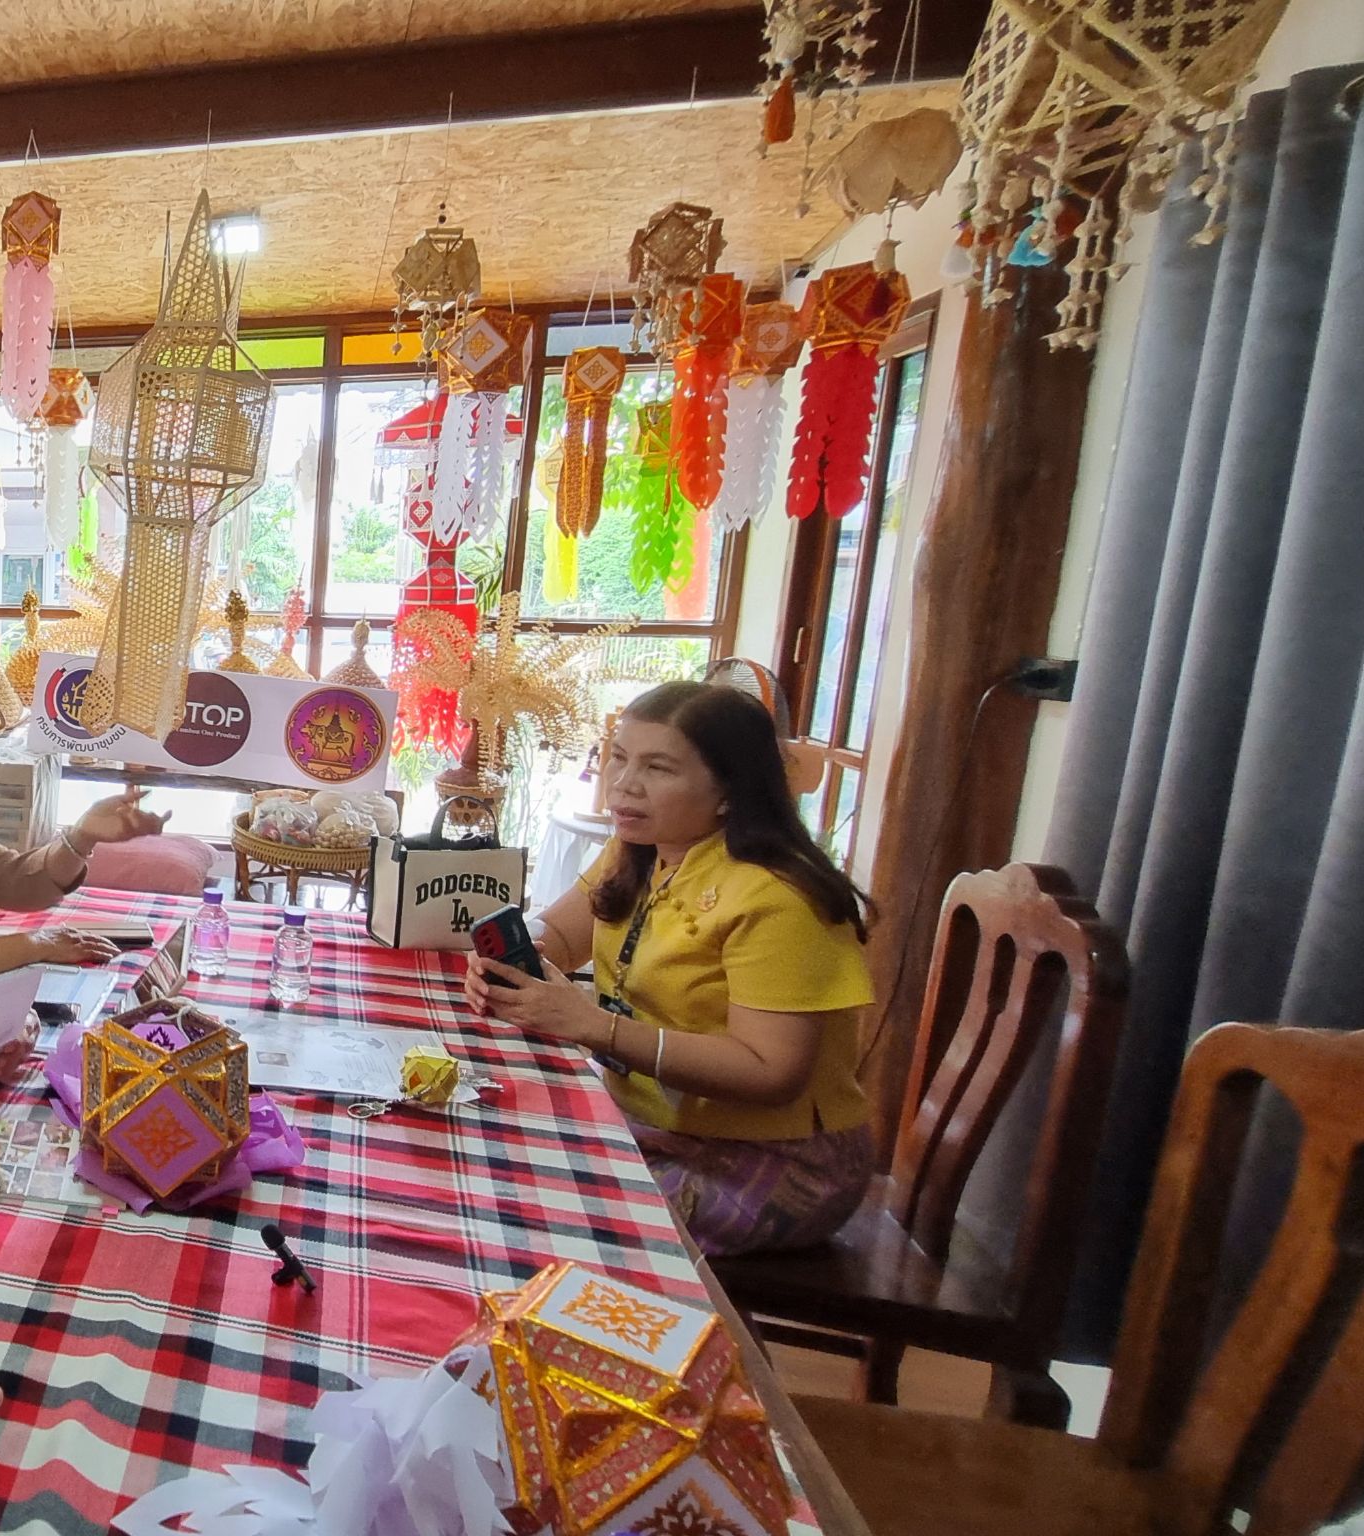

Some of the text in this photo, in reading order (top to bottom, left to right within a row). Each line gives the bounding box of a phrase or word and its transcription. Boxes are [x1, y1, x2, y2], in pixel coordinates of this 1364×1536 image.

[183, 701, 244, 728] TOP
[36, 716, 127, 752] กรมการพัฒนาชุมชน
[216, 731, 241, 740] Product
[416, 874, 511, 905] DODGERS
[451, 899, 474, 932] LA
